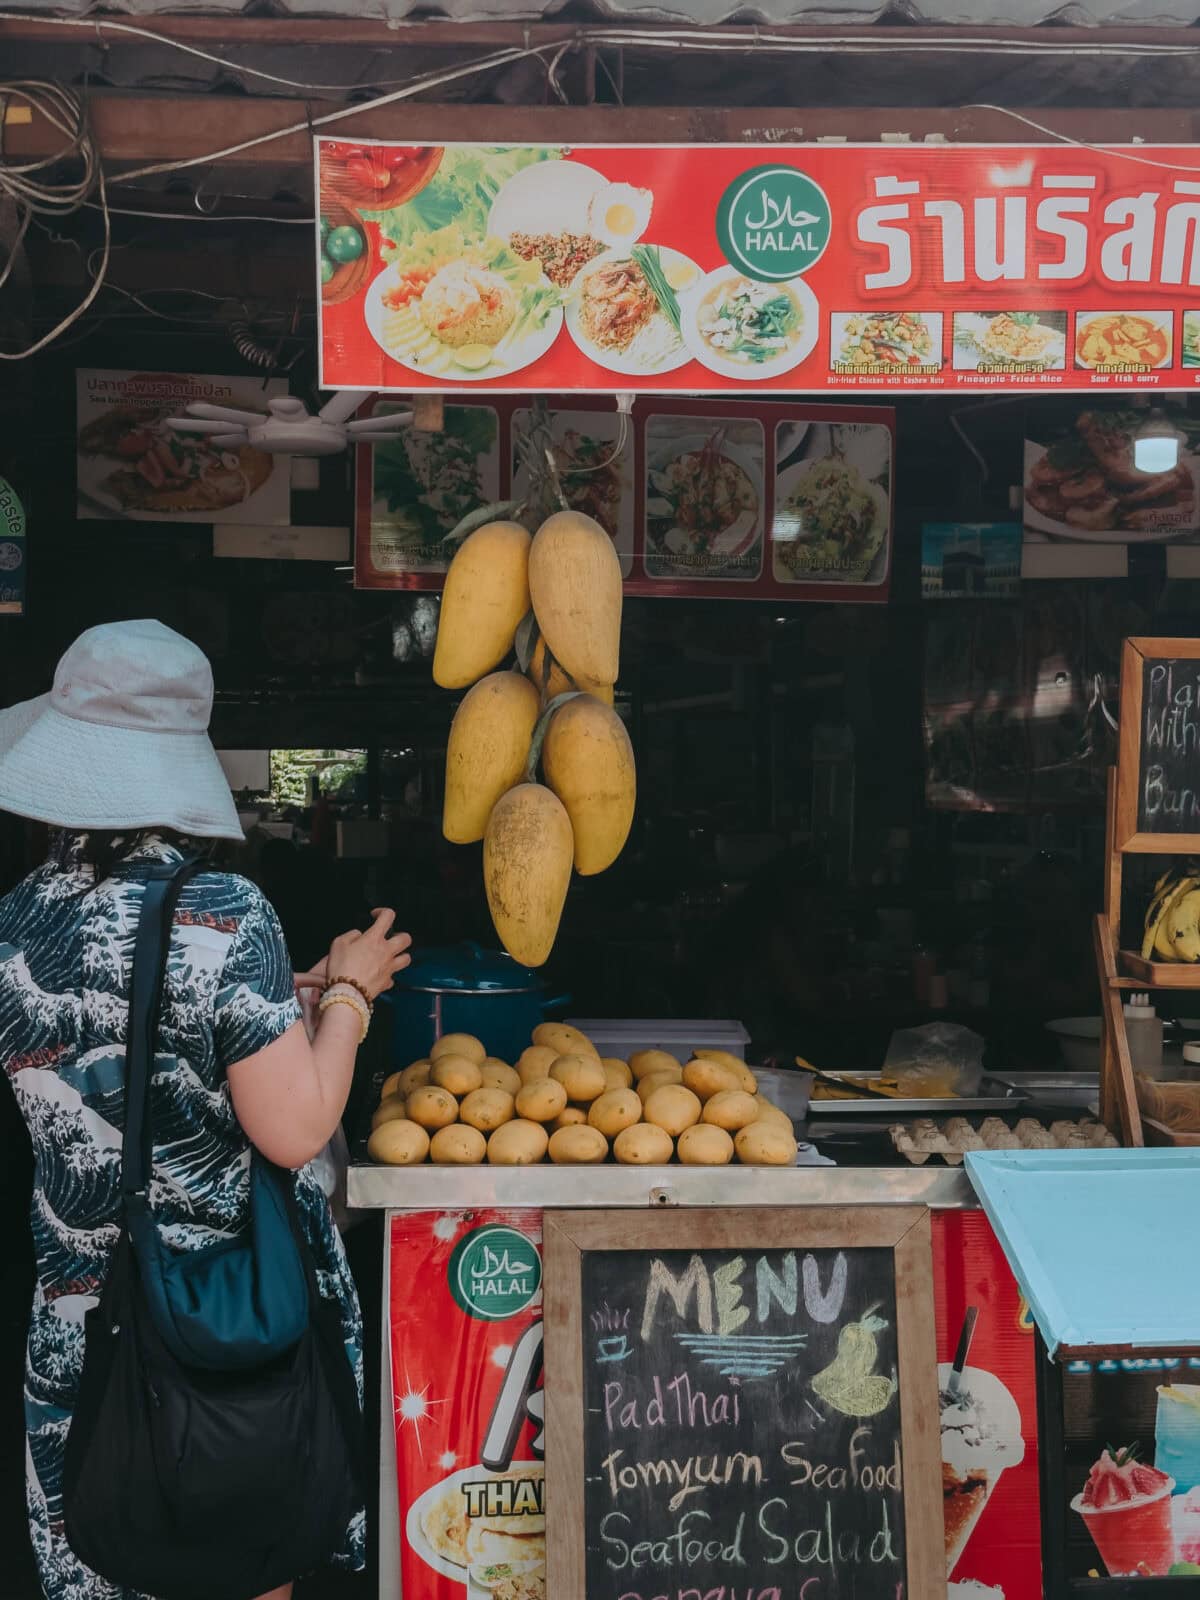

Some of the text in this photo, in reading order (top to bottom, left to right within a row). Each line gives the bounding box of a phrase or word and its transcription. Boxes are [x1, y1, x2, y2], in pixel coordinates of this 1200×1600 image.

[745, 189, 821, 230] حلال
[745, 231, 819, 251] HALAL
[859, 376, 884, 385] Chicken
[887, 376, 901, 385] with
[903, 376, 928, 385] Cashew
[957, 375, 1063, 385] Pineapple Fried Rice
[1091, 375, 1110, 383] Sour
[1137, 375, 1160, 384] curry
[1145, 764, 1200, 815] Ban
[471, 1245, 534, 1278] حلال
[471, 1279, 532, 1296] HALAL
[641, 1251, 848, 1341] MENU
[600, 1511, 746, 1569] Seafood
